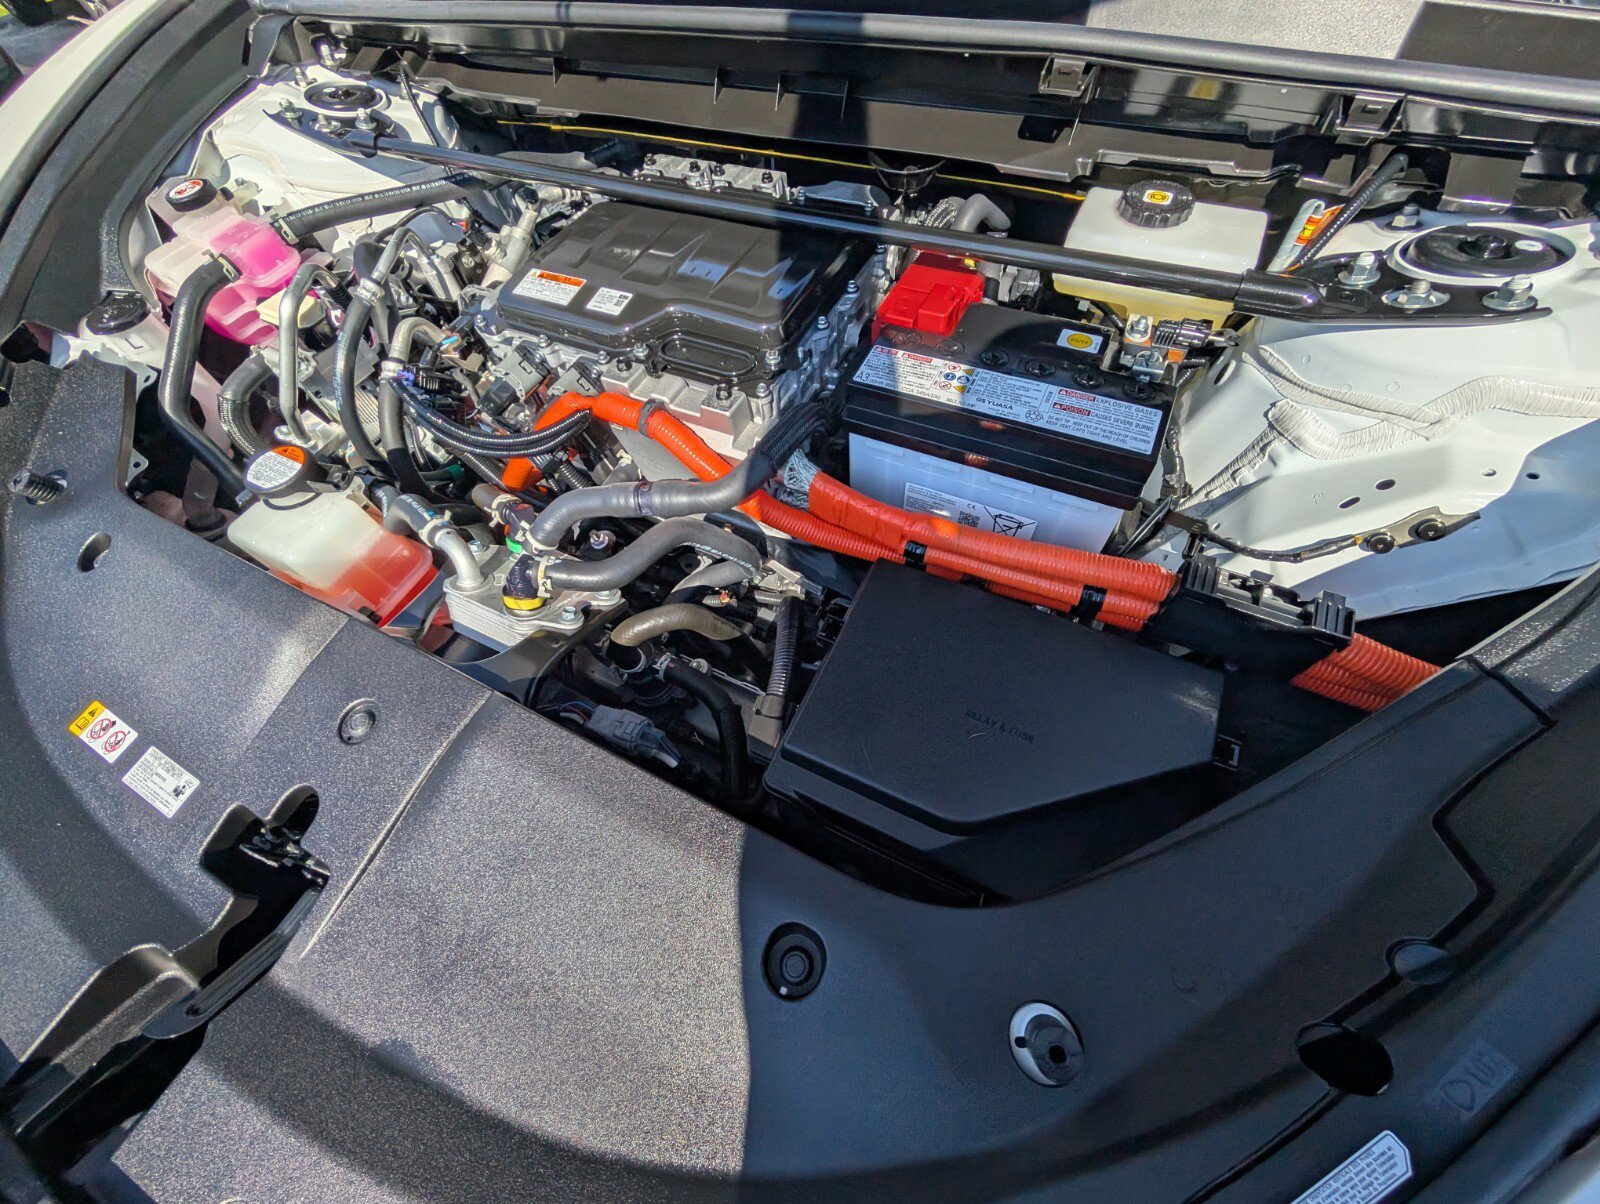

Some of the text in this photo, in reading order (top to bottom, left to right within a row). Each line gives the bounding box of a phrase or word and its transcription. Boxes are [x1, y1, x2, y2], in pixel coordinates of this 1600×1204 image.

[856, 371, 870, 382] A3
[987, 400, 1014, 410] YUASA
[1066, 390, 1095, 402] DANGER
[1096, 397, 1134, 412] EXPLOSIVE
[1135, 406, 1158, 418] GASES
[1060, 405, 1090, 416] POISON
[1091, 411, 1113, 422] CAUSES
[1113, 417, 1134, 428] SEVERE
[1135, 422, 1155, 433] BURNS
